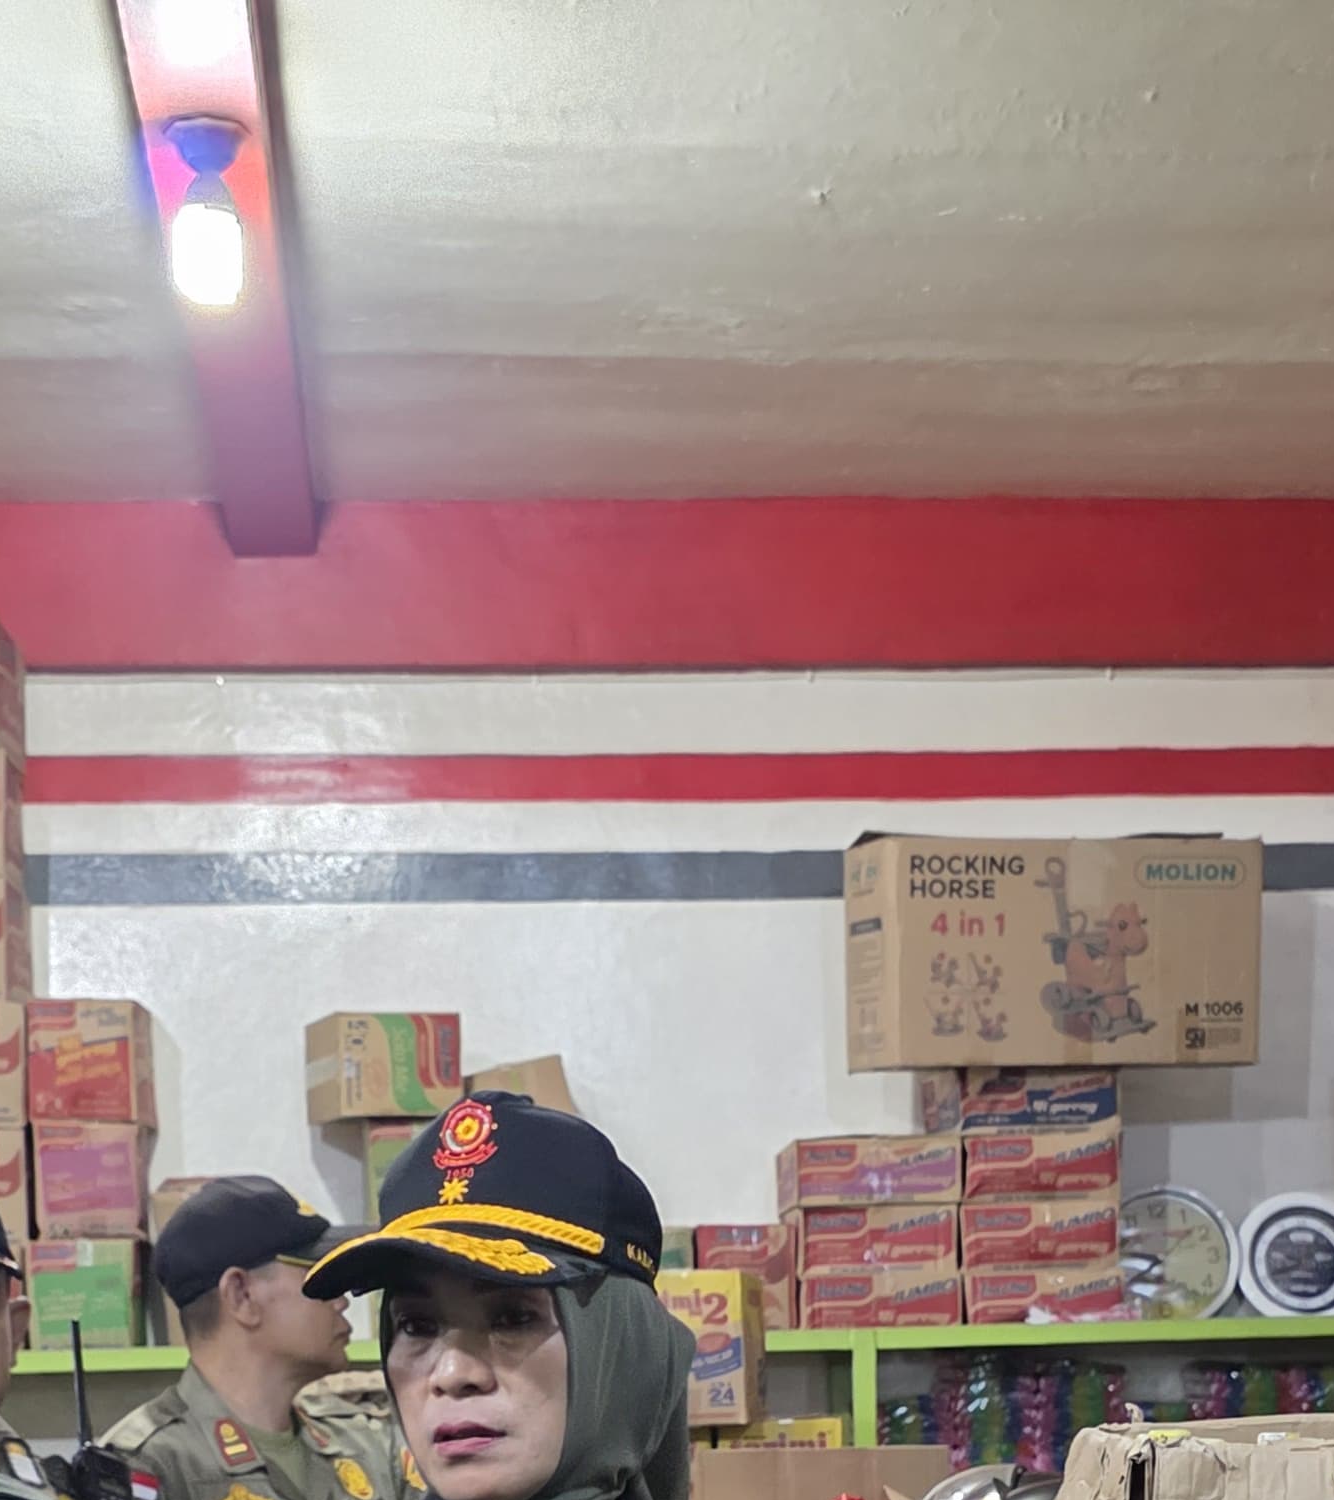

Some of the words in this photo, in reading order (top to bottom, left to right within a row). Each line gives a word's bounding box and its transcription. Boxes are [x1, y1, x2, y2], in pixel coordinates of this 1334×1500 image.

[910, 855, 1025, 876] ROCKING
[1146, 864, 1236, 881] MOLION
[910, 879, 995, 899] HORSE
[931, 912, 948, 936] 4
[959, 909, 985, 936] in
[995, 912, 1005, 936] 1
[1185, 1003, 1199, 1016] M
[1206, 1002, 1244, 1016] 1006
[1147, 1204, 1165, 1218] 12
[1200, 1224, 1210, 1240] 2
[703, 1293, 728, 1326] 2
[708, 1388, 735, 1401] 24
